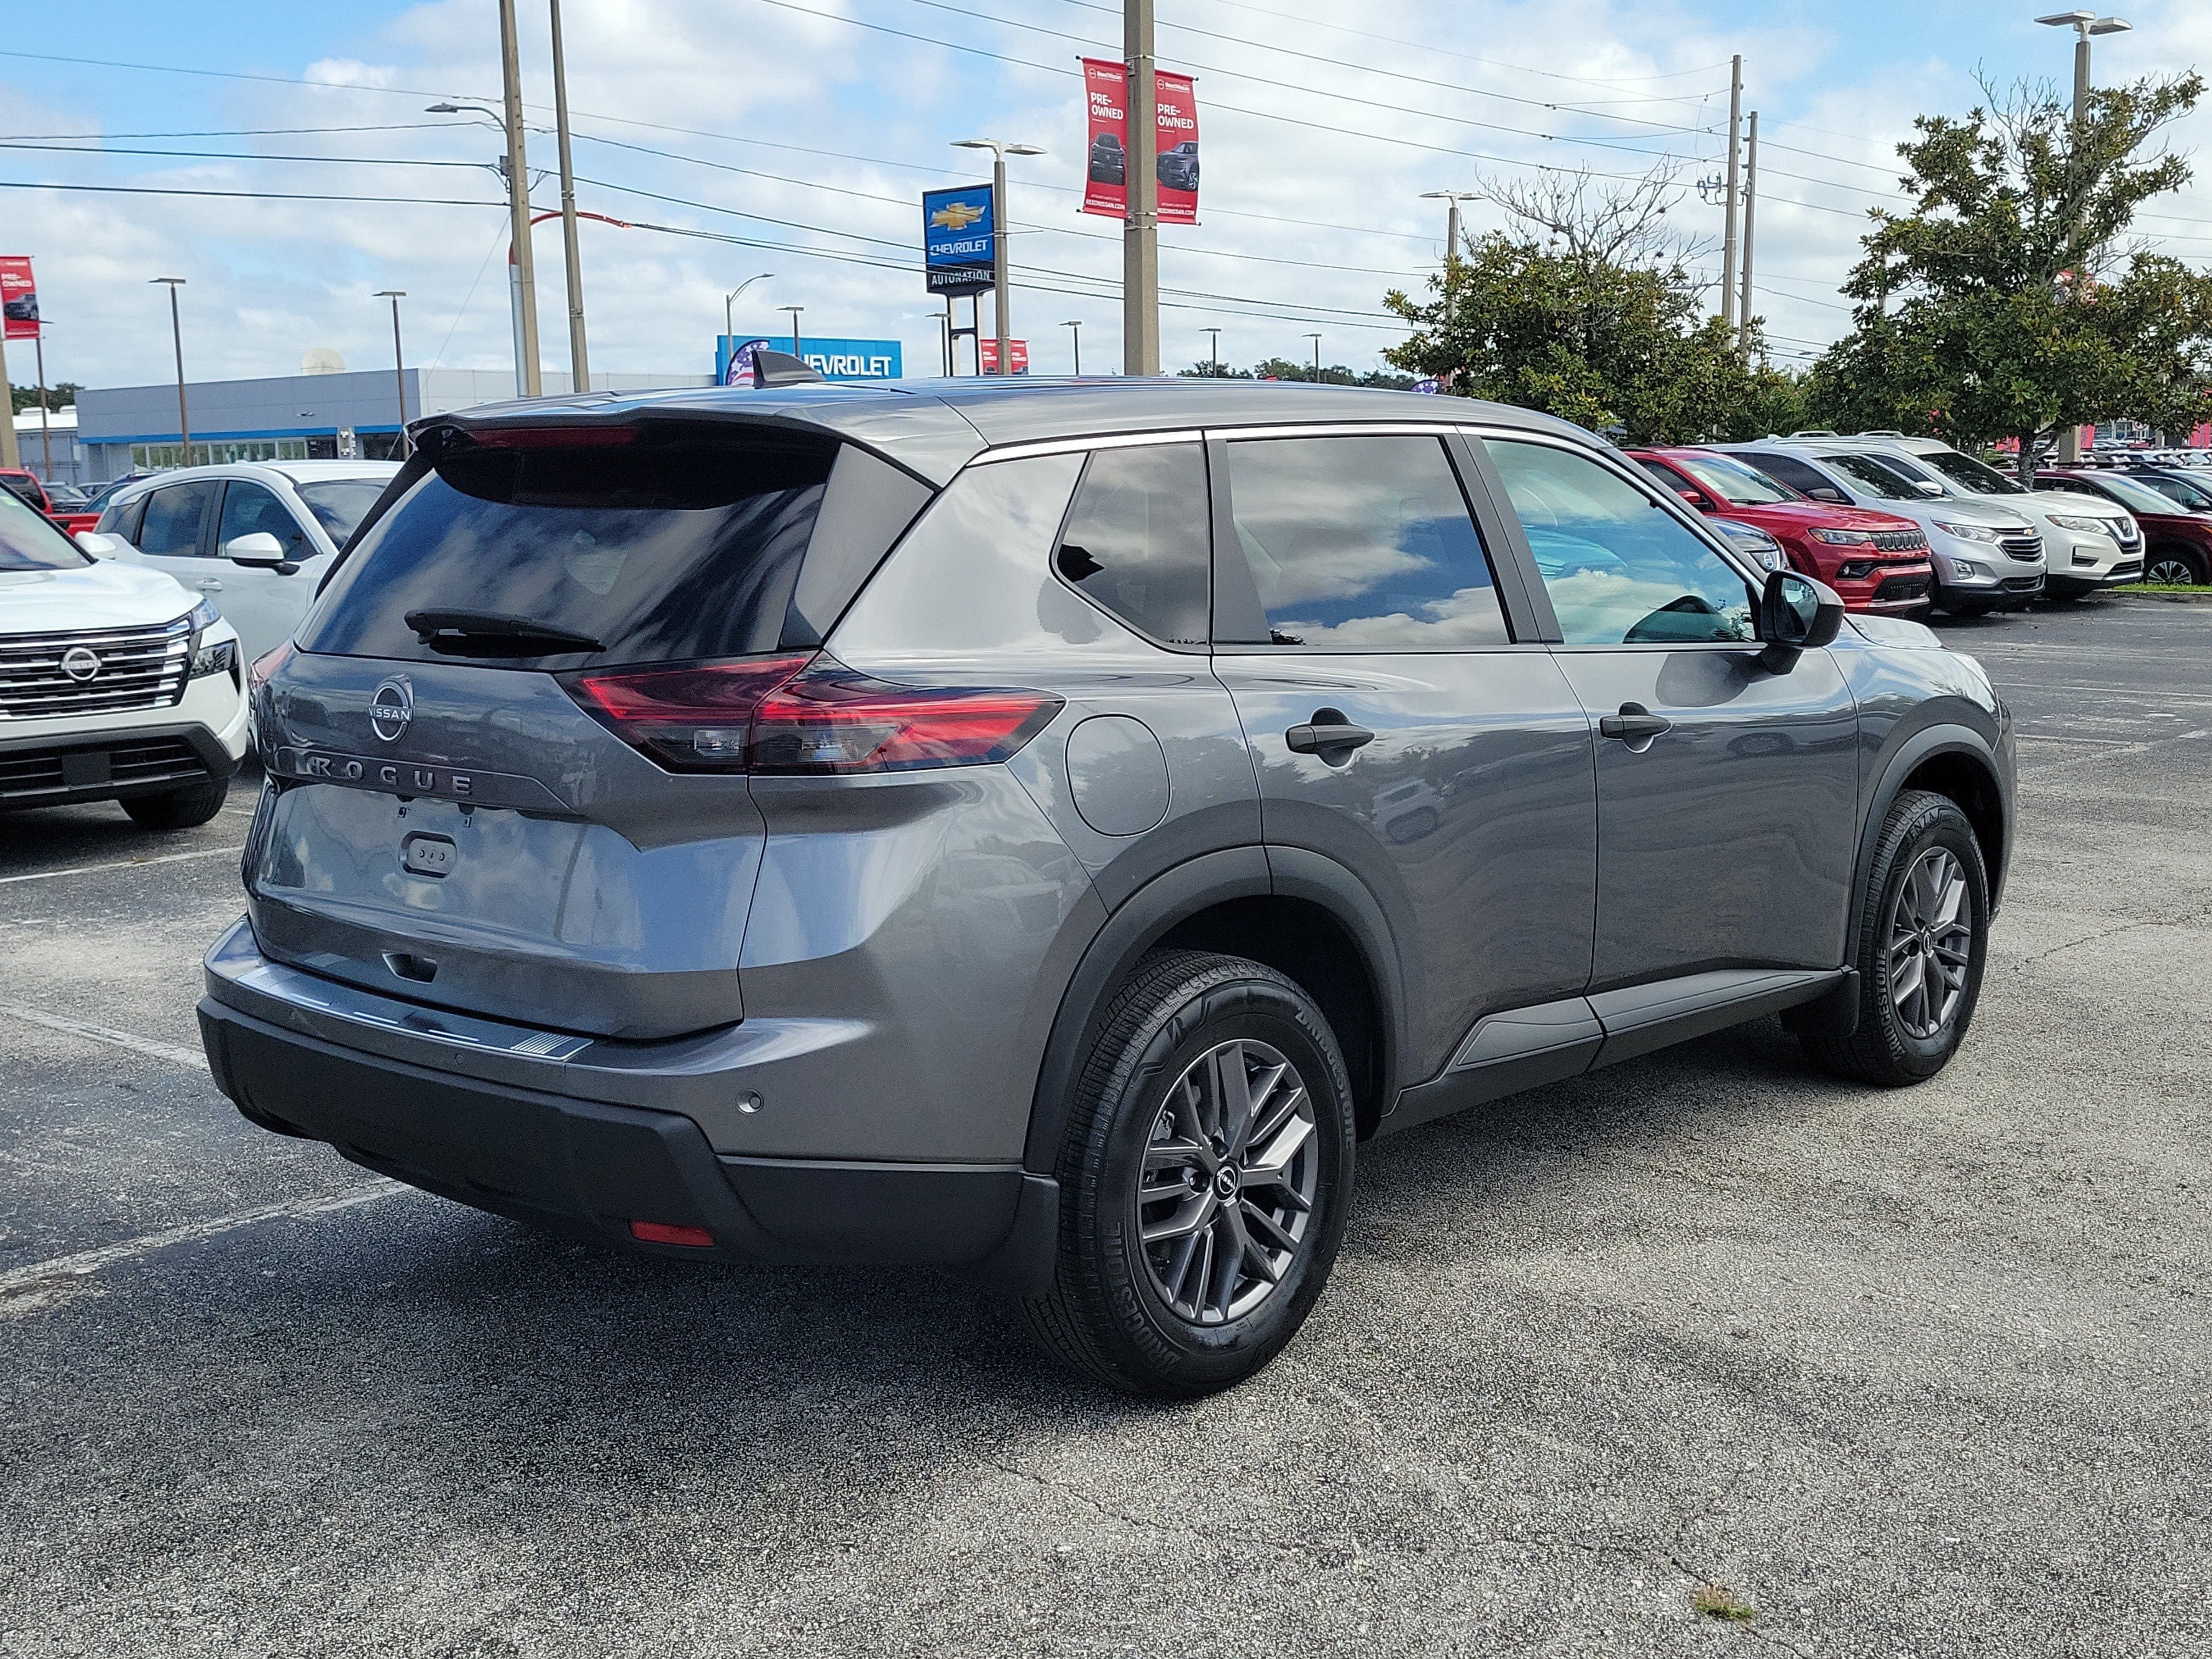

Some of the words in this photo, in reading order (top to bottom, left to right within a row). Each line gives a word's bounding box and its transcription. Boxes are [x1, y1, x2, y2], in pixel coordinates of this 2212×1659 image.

[1090, 92, 1113, 105] PRE-
[1091, 104, 1124, 120] OWNED
[1158, 103, 1182, 116] PRE-
[1158, 115, 1194, 129] OWNED
[929, 239, 989, 256] CHEVROLET
[931, 269, 990, 285] AUTONATION
[802, 354, 893, 377] EVROLET
[368, 706, 410, 720] NISSAN
[307, 756, 471, 796] ROGUE
